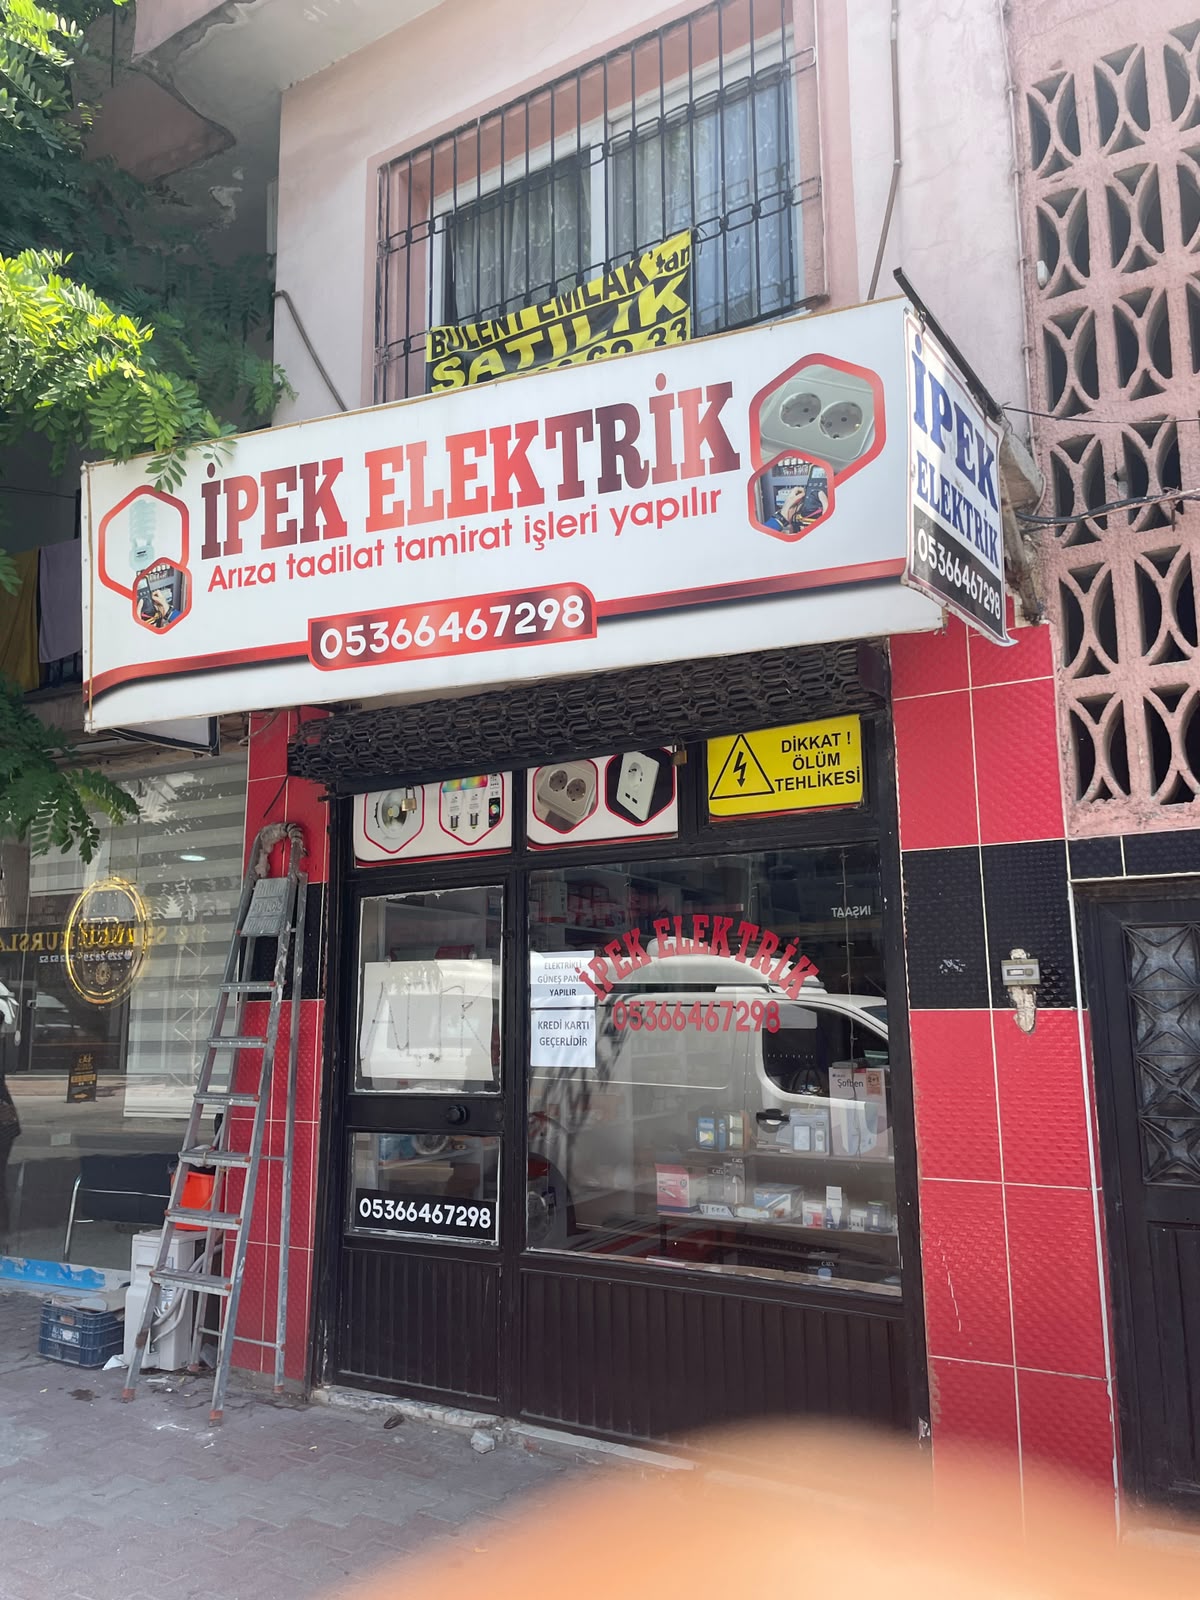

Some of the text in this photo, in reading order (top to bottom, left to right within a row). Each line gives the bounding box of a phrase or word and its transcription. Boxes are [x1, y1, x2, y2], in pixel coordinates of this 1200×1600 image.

[430, 272, 688, 393] SATILIK
[911, 334, 999, 512] İPEK
[201, 372, 740, 560] İPEK ELEKTRİK
[916, 450, 999, 569] ELEKTRİK
[207, 487, 722, 592] Arıza tadilat tamirat işleri yapılır
[918, 528, 1001, 620] 05366467298
[319, 595, 585, 660] 05366467298
[781, 733, 841, 753] DİKKAT
[792, 752, 840, 771] ÖLÜM
[774, 766, 860, 792] TEHLİKESİ
[574, 914, 820, 1001] İPEK ELEKTRİK
[537, 974, 580, 984] GÜNEŞ PAN
[549, 988, 577, 997] YAPILIR
[537, 1019, 590, 1030] KREDİ KARTI
[612, 1000, 780, 1034] 05366467298
[539, 1035, 588, 1048] GEÇERLİDİR
[359, 1197, 491, 1229] 05366467298
